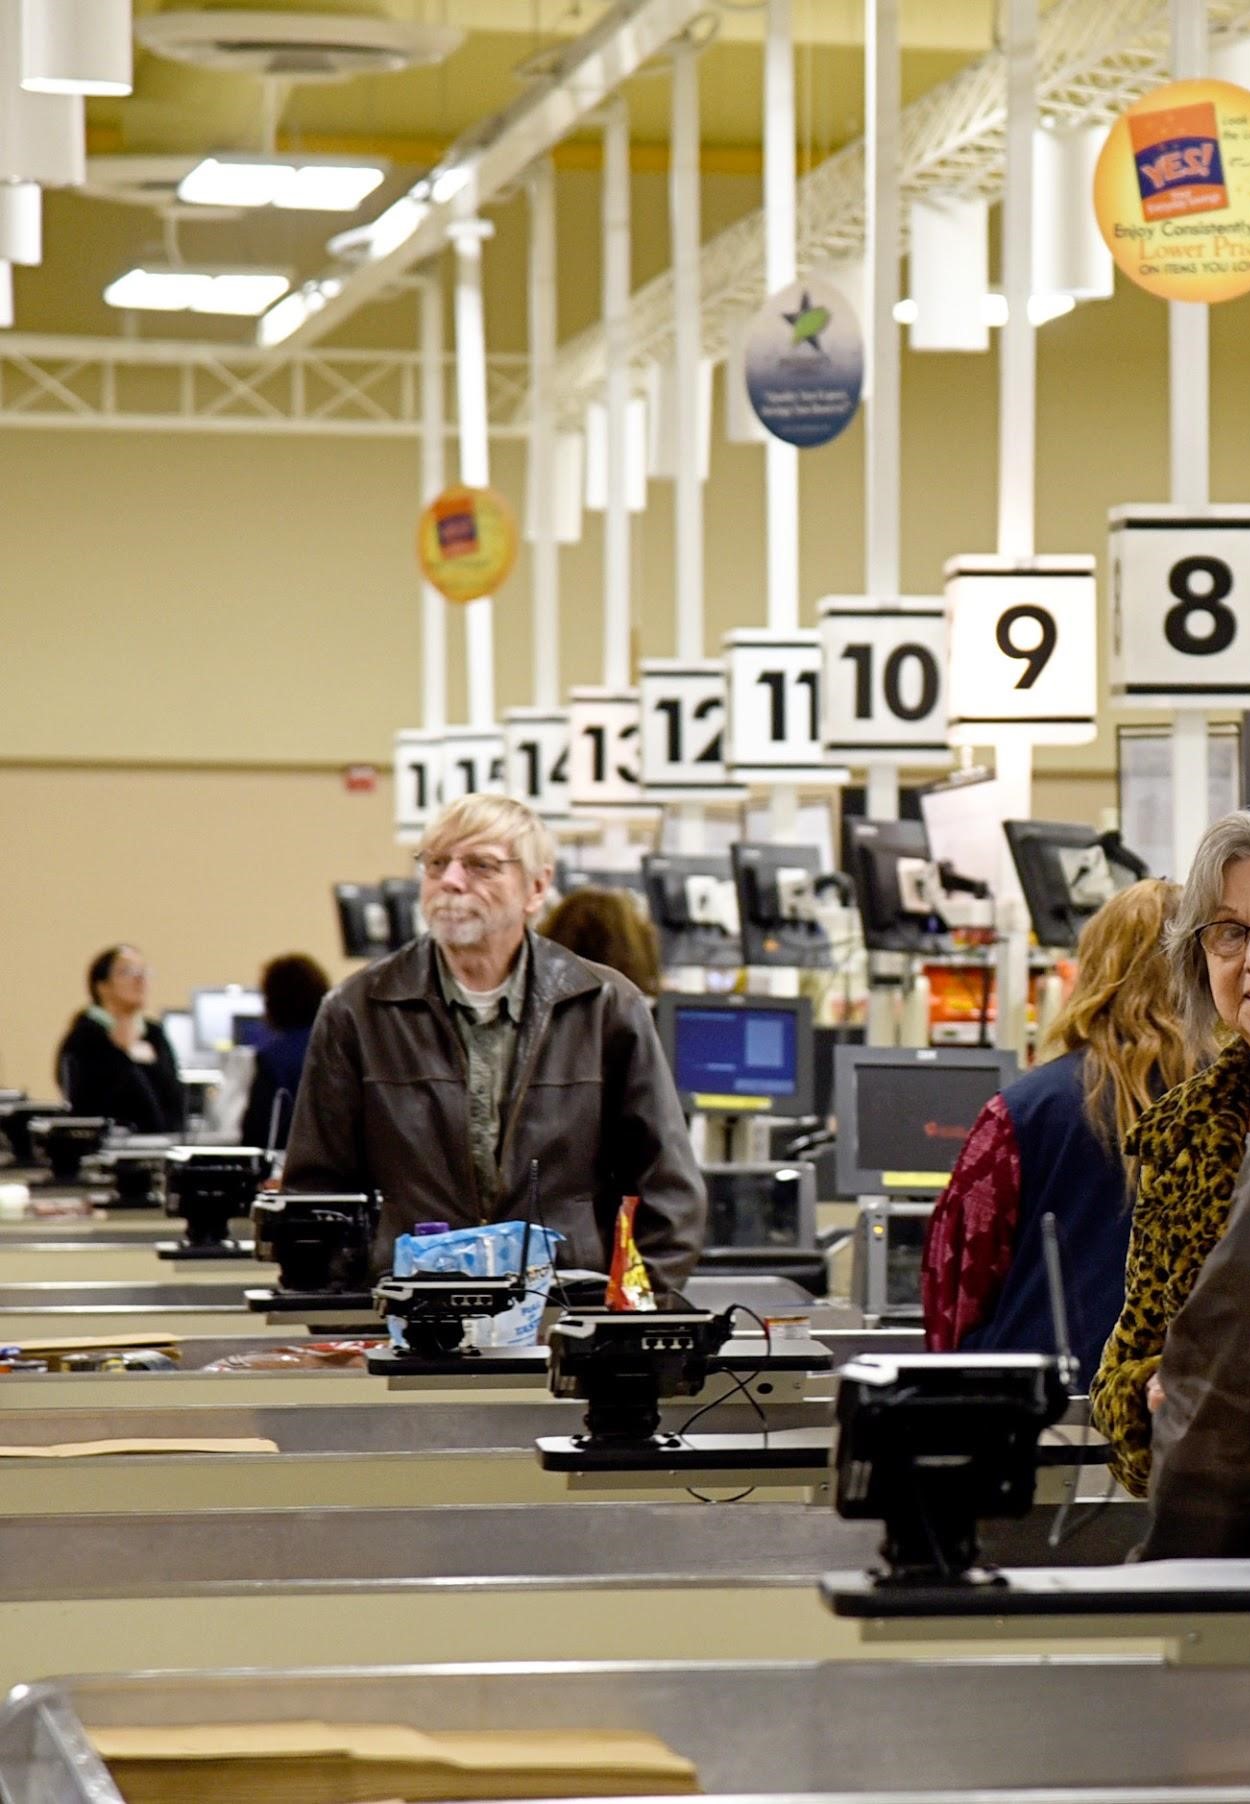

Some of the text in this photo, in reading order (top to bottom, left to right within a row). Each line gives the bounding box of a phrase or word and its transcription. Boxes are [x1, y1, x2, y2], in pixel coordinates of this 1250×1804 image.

[1140, 142, 1215, 190] YES!
[1114, 222, 1154, 240] Enjoy
[1139, 238, 1206, 261] Lower
[1201, 261, 1228, 274] YOU
[1163, 554, 1238, 657] 8
[995, 603, 1058, 690] 9
[755, 670, 820, 743] 11
[840, 641, 940, 722] 10
[655, 697, 724, 763] 12
